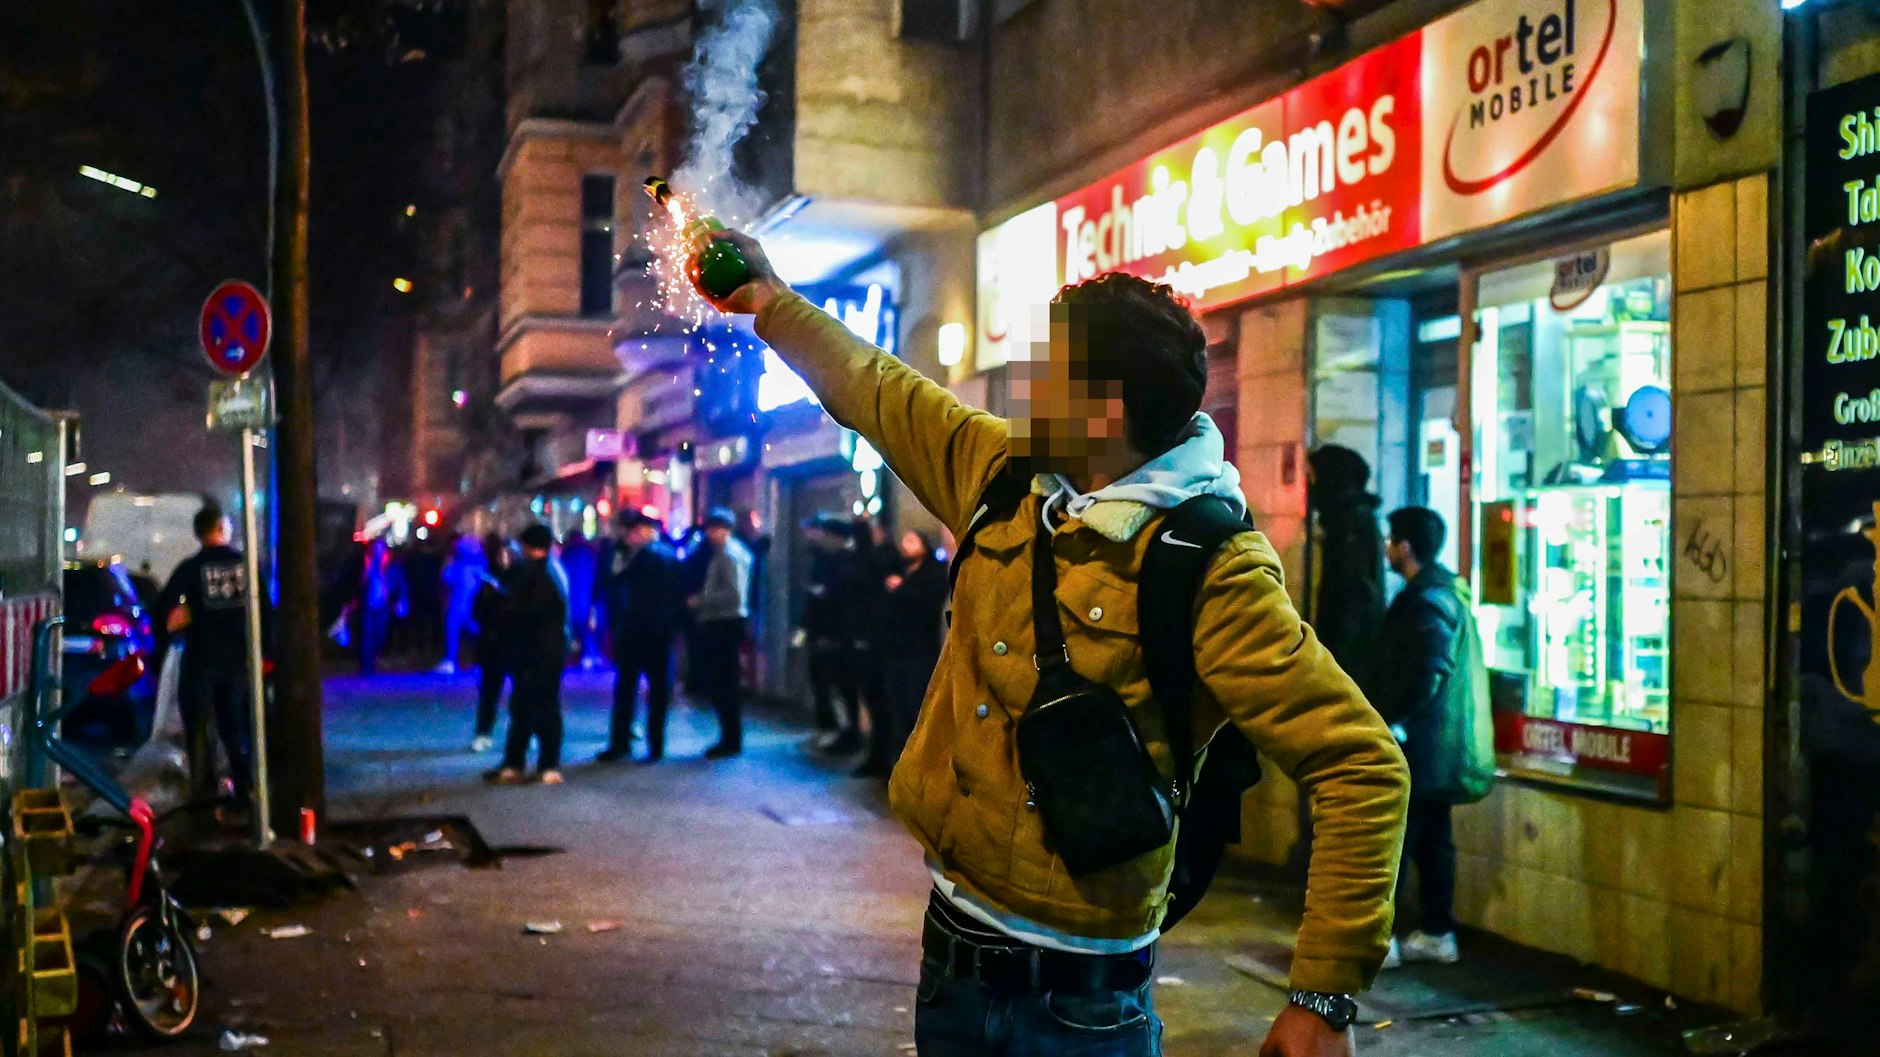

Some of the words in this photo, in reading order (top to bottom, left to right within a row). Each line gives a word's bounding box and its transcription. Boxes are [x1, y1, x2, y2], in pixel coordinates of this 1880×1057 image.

[1467, 0, 1575, 94] ortel
[1469, 63, 1575, 129] MOBILE
[1062, 164, 1187, 284] Technic
[1226, 94, 1396, 226] Games
[1826, 314, 1880, 364] Zub
